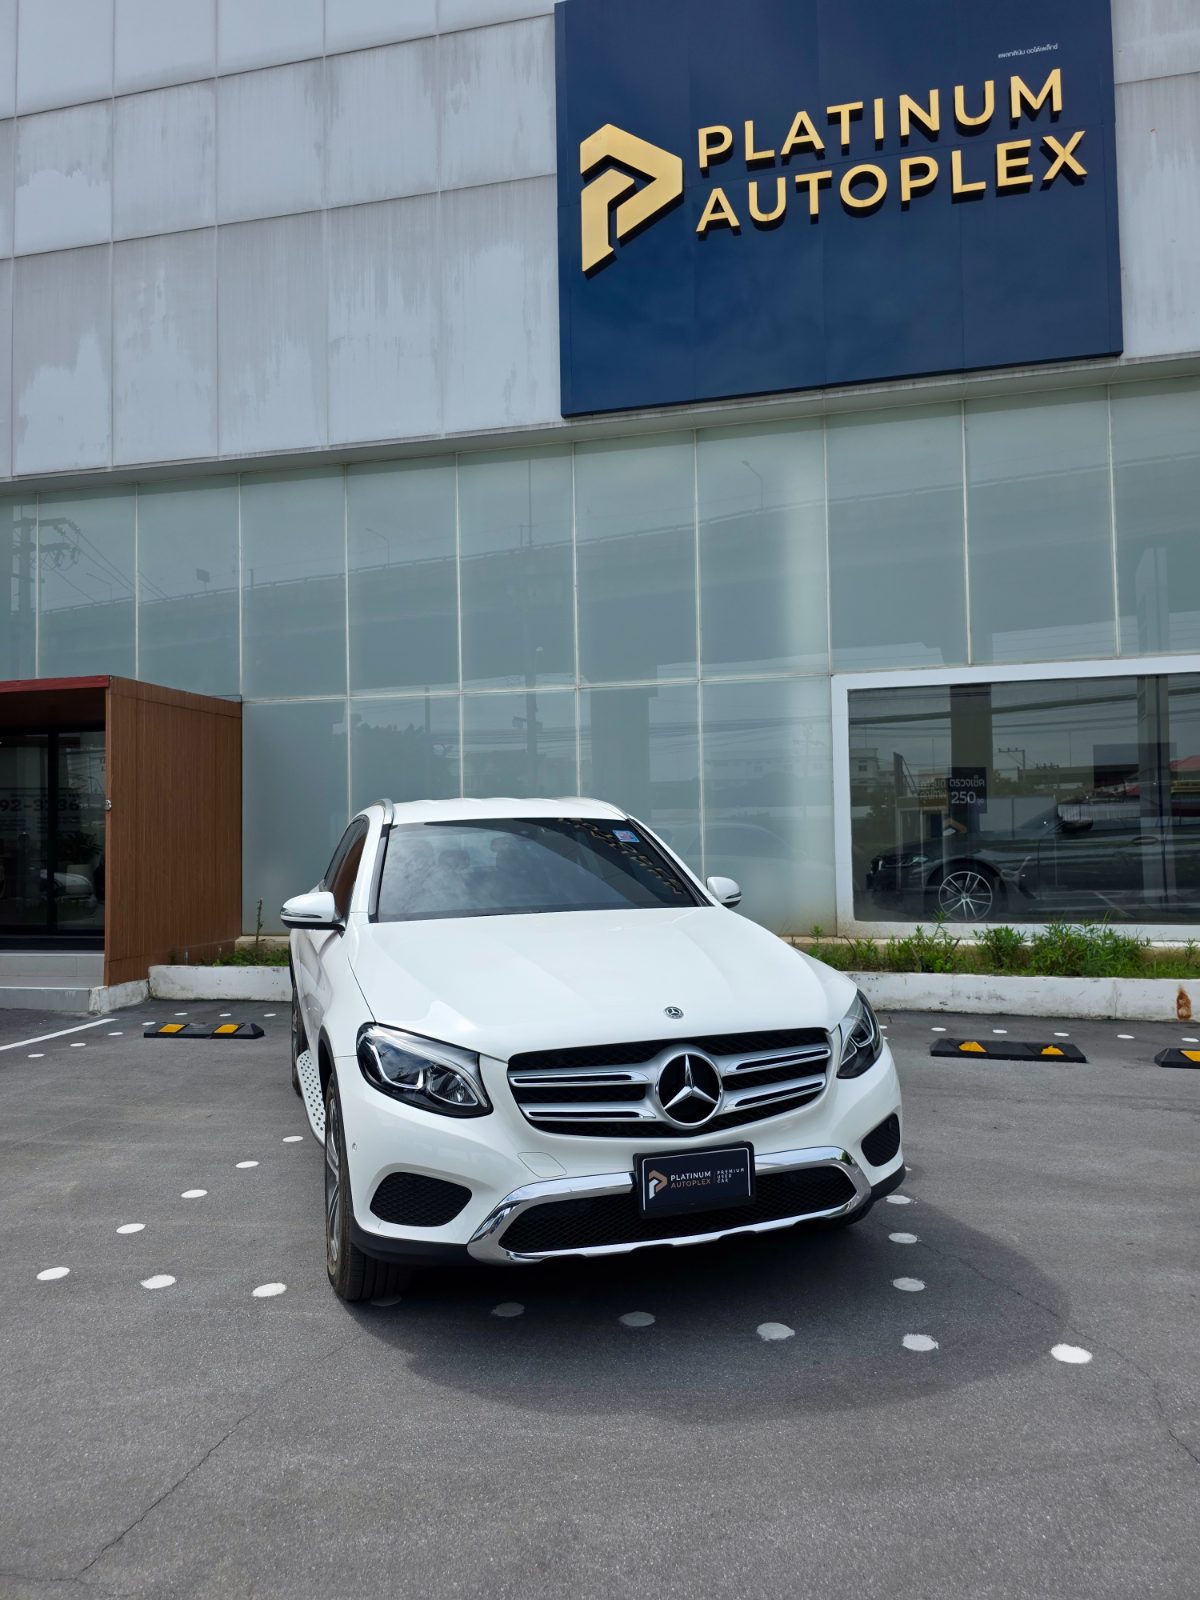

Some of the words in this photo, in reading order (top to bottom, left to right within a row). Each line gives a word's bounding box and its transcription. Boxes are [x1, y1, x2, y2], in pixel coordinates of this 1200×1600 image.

[697, 68, 1063, 171] PLATINUM
[696, 130, 1087, 233] AUTOPLEX
[951, 791, 976, 804] 250
[670, 1171, 711, 1182] PLATINUM
[670, 1179, 711, 1189] AUTOPLEX
